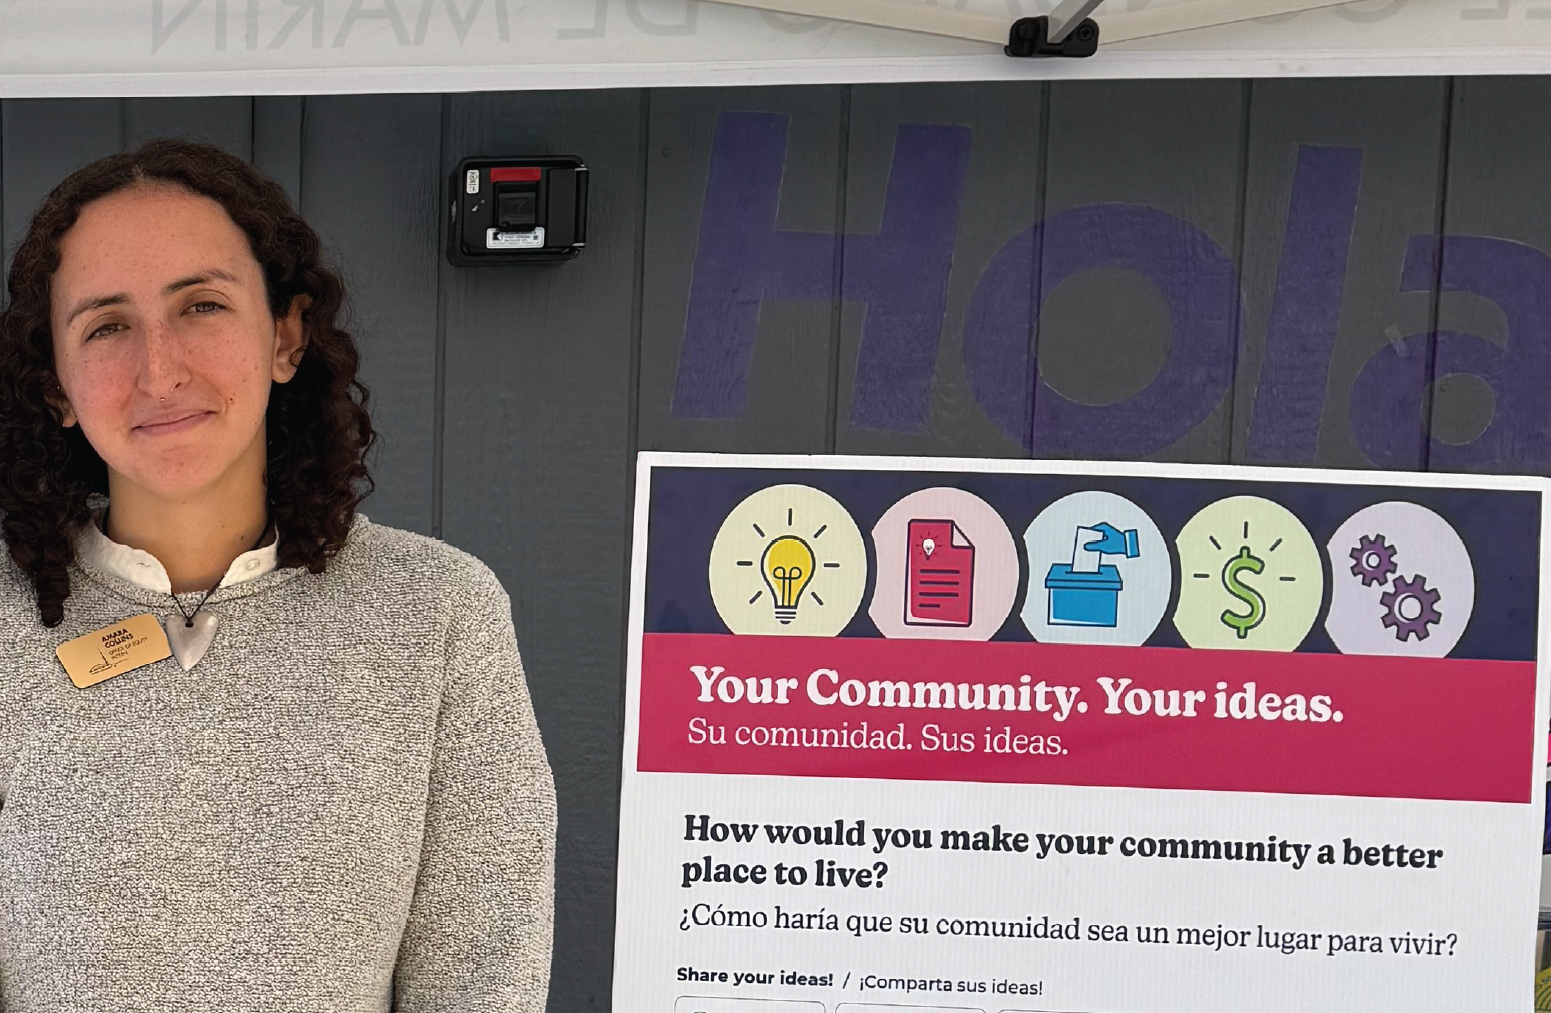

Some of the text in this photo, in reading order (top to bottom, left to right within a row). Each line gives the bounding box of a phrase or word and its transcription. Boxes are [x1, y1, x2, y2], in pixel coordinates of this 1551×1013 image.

[669, 111, 1551, 470] Hola
[689, 665, 1344, 723] Your Community. Your ideas.
[688, 717, 1068, 755] Su comunidad. Sus ideas.
[683, 814, 1444, 870] How would you make your community a better
[681, 855, 889, 889] place to live?
[679, 903, 1458, 957] ¿Cómo haría que su comunidad sea un mejor lugar para vivir?
[676, 966, 729, 983] Share
[732, 972, 775, 987] your
[780, 969, 833, 987] ideas!
[859, 975, 953, 994] ¡Comparta
[956, 980, 987, 993] sus
[992, 978, 1043, 996] ideas!
